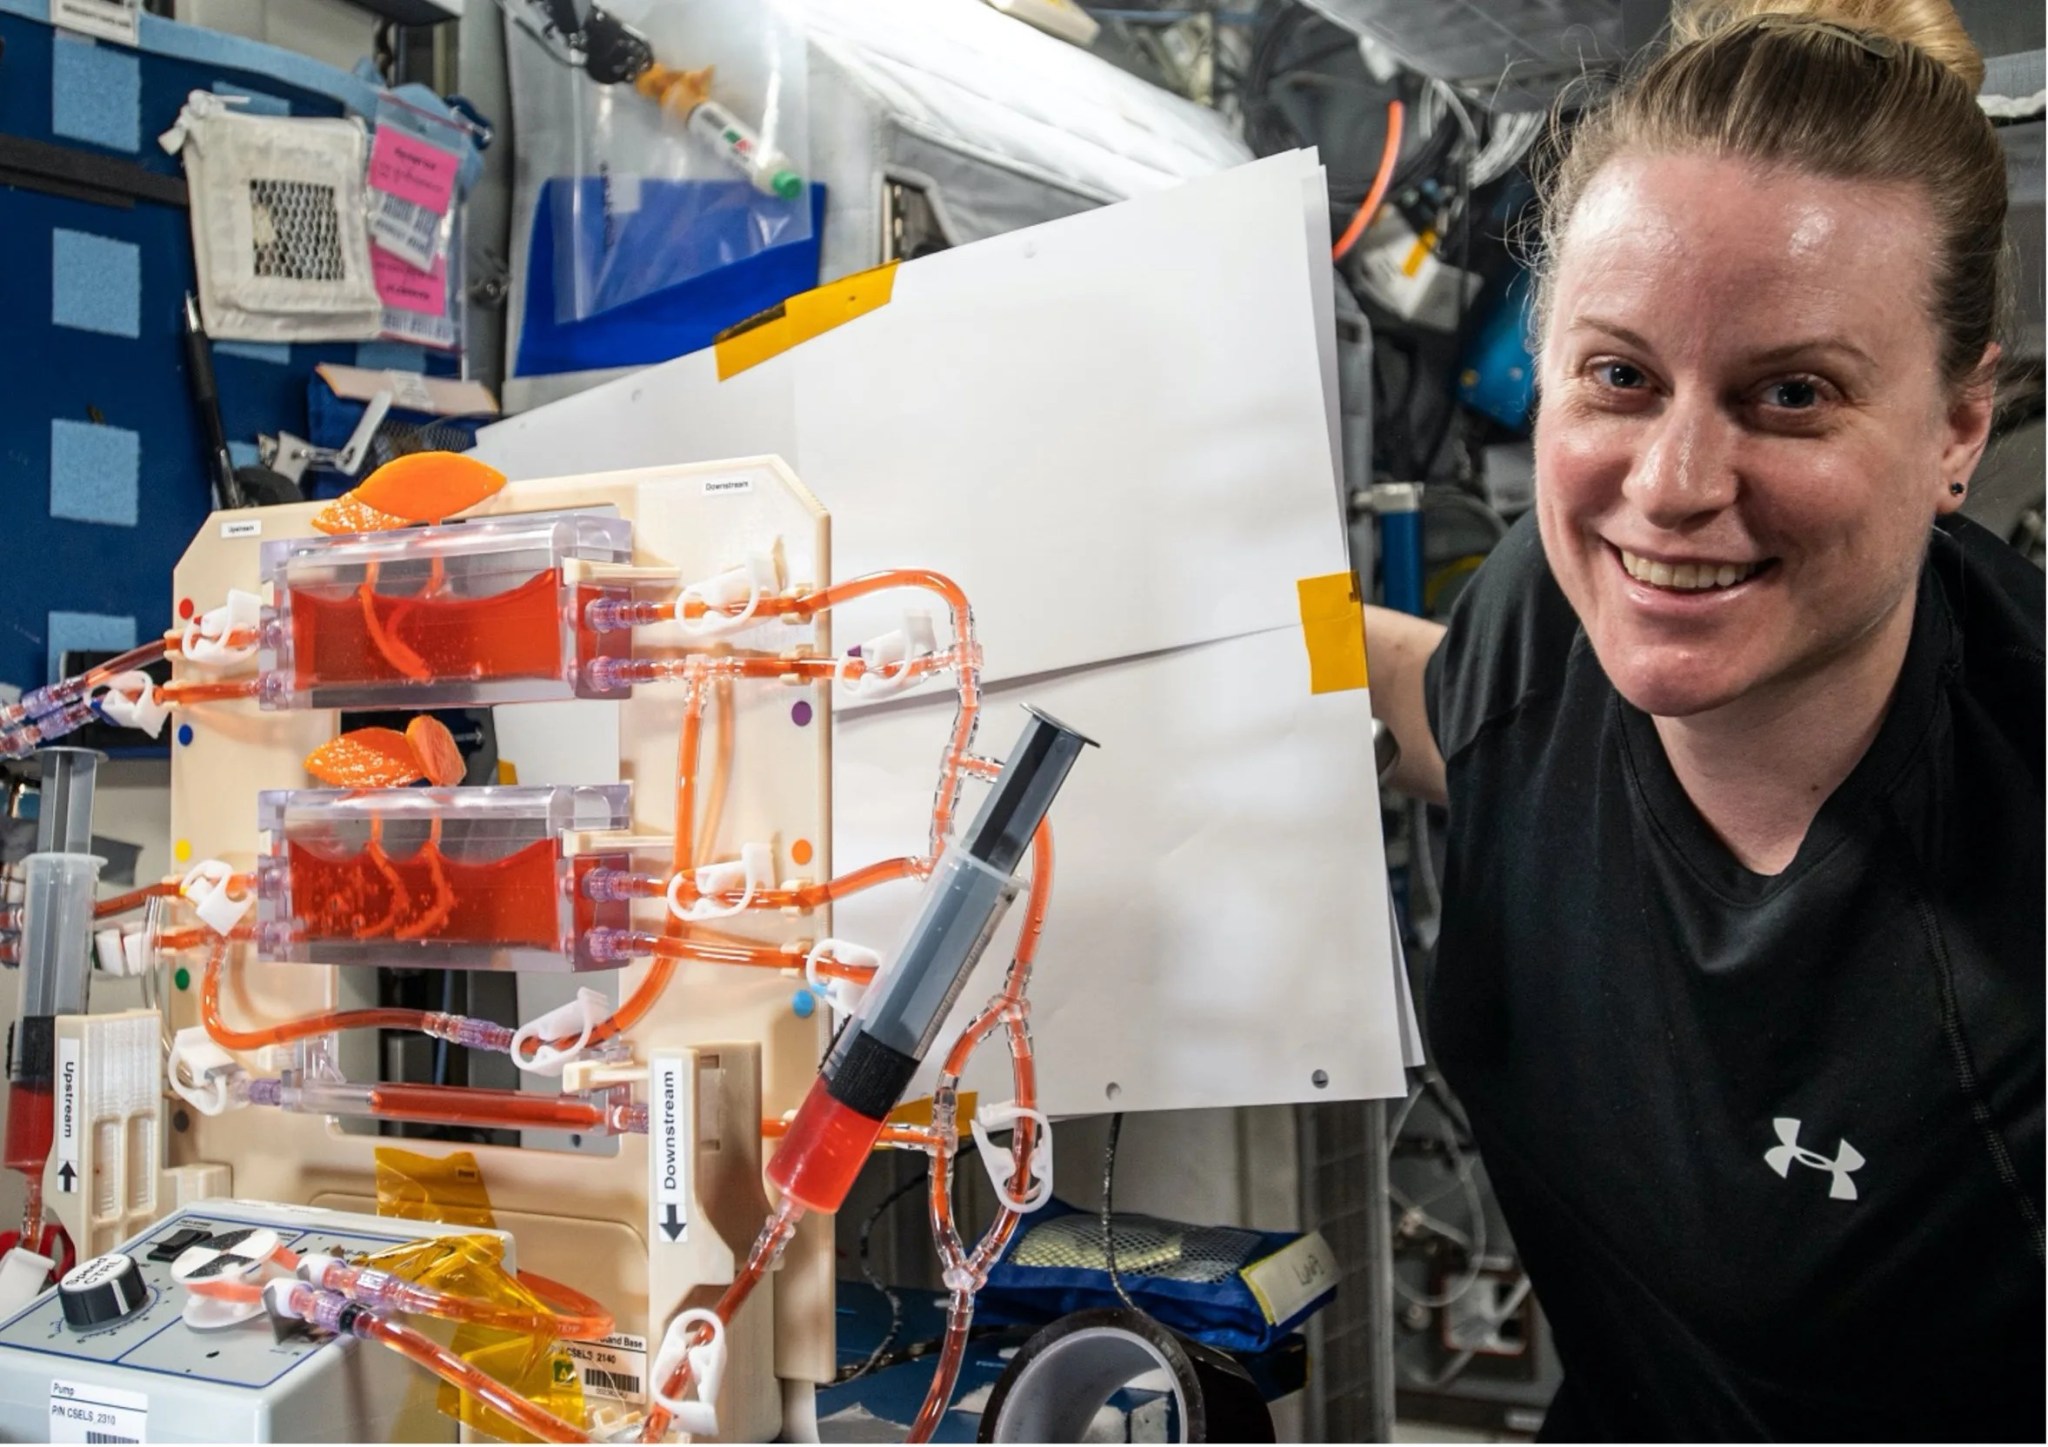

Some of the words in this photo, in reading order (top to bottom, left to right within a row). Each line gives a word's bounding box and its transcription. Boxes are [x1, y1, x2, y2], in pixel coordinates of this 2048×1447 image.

[705, 481, 749, 491] Downstream
[63, 1061, 75, 1138] Upstream
[664, 1071, 677, 1190] Downstream
[65, 1257, 108, 1286] Speed
[84, 1259, 122, 1285] CTRL
[623, 1337, 643, 1348] Base
[54, 1382, 75, 1396] Pump
[51, 1405, 66, 1417] P/N
